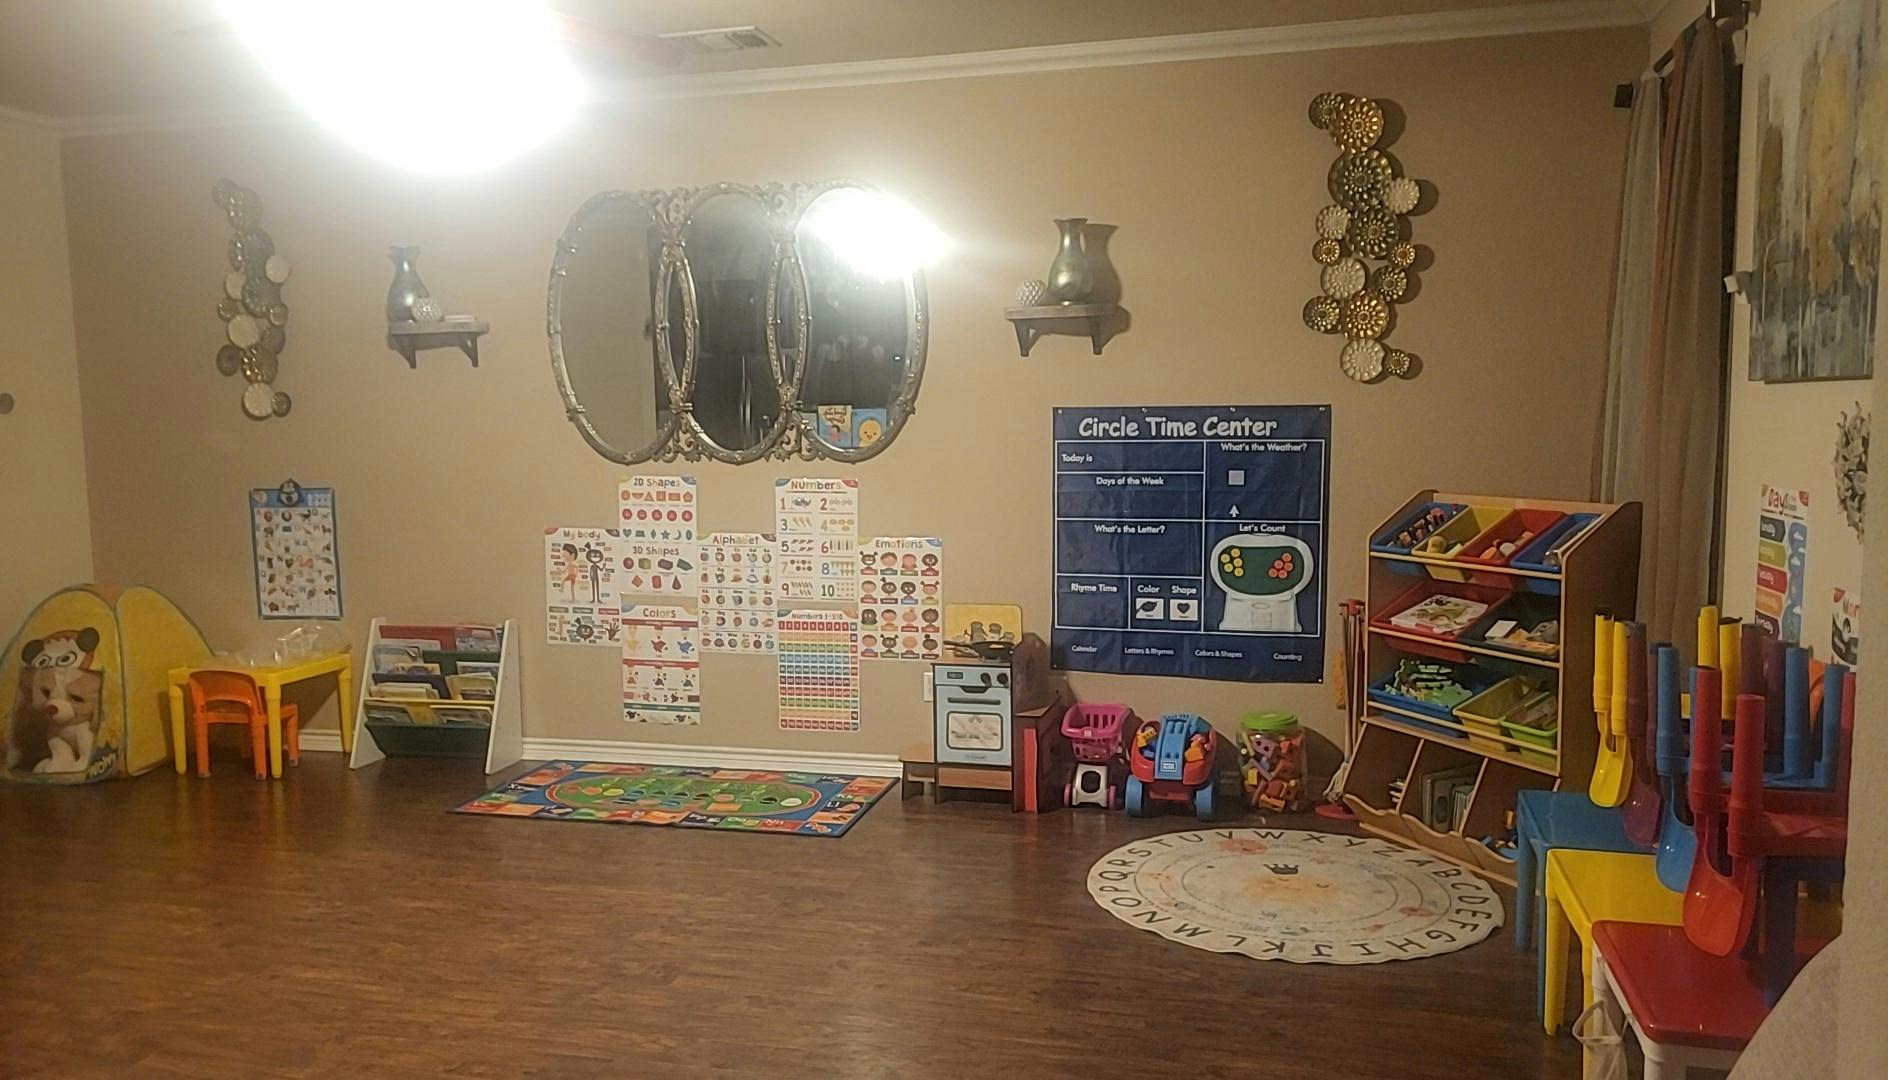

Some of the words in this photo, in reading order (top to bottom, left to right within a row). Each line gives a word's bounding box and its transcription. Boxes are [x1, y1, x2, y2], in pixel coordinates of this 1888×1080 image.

[1078, 416, 1140, 438] Circle
[1145, 416, 1198, 438] Time
[1202, 416, 1278, 437] Center
[1220, 443, 1249, 452] What's
[1251, 443, 1265, 452] the
[1266, 443, 1308, 452] Weather?
[1061, 453, 1085, 464] Today
[1086, 454, 1093, 463] is
[633, 478, 644, 487] 2D
[646, 478, 681, 488] Shapes
[1096, 477, 1116, 487] Days
[1117, 477, 1126, 486] of
[1127, 477, 1140, 486] the
[1141, 477, 1164, 486] Week
[780, 498, 786, 510] 1
[820, 498, 828, 511] 2
[781, 519, 788, 531] 3
[820, 520, 828, 532] 4
[1094, 525, 1122, 534] What's
[1123, 525, 1136, 534] the
[1137, 525, 1166, 534] Letter?
[1239, 524, 1259, 533] Let's
[1260, 524, 1286, 533] Count
[577, 530, 601, 540] body
[712, 535, 760, 546] Alphabet
[781, 540, 790, 552] 5
[820, 541, 829, 554] 6
[875, 539, 923, 549] Emotions
[646, 546, 680, 557] Shapes
[781, 561, 789, 573] 7
[821, 563, 830, 575] 8
[781, 583, 790, 595] 9
[821, 585, 835, 597] 10
[1070, 583, 1097, 593] Rhyme
[1098, 583, 1118, 593] Time
[1137, 585, 1160, 594] Color
[1171, 585, 1197, 595] Shape
[1124, 647, 1144, 655] Letters
[1195, 649, 1214, 657] Colors
[1221, 650, 1243, 659] Shapes
[1178, 833, 1204, 843] U
[1216, 831, 1233, 840] V
[1253, 830, 1285, 840] W
[1302, 833, 1327, 844] X
[1147, 838, 1173, 848] T
[1127, 847, 1153, 858] S
[1107, 858, 1136, 868] R
[1098, 870, 1136, 881] Q
[1432, 868, 1462, 879] B
[1099, 885, 1131, 894] P
[1451, 882, 1483, 891] C
[1111, 896, 1142, 908] O
[1457, 895, 1490, 905] D
[1133, 911, 1173, 924] N
[1455, 907, 1492, 920] E
[1447, 919, 1480, 933] F
[1226, 934, 1248, 946] L
[1425, 929, 1457, 943] G
[1261, 940, 1286, 953] K
[1385, 937, 1427, 952] H
